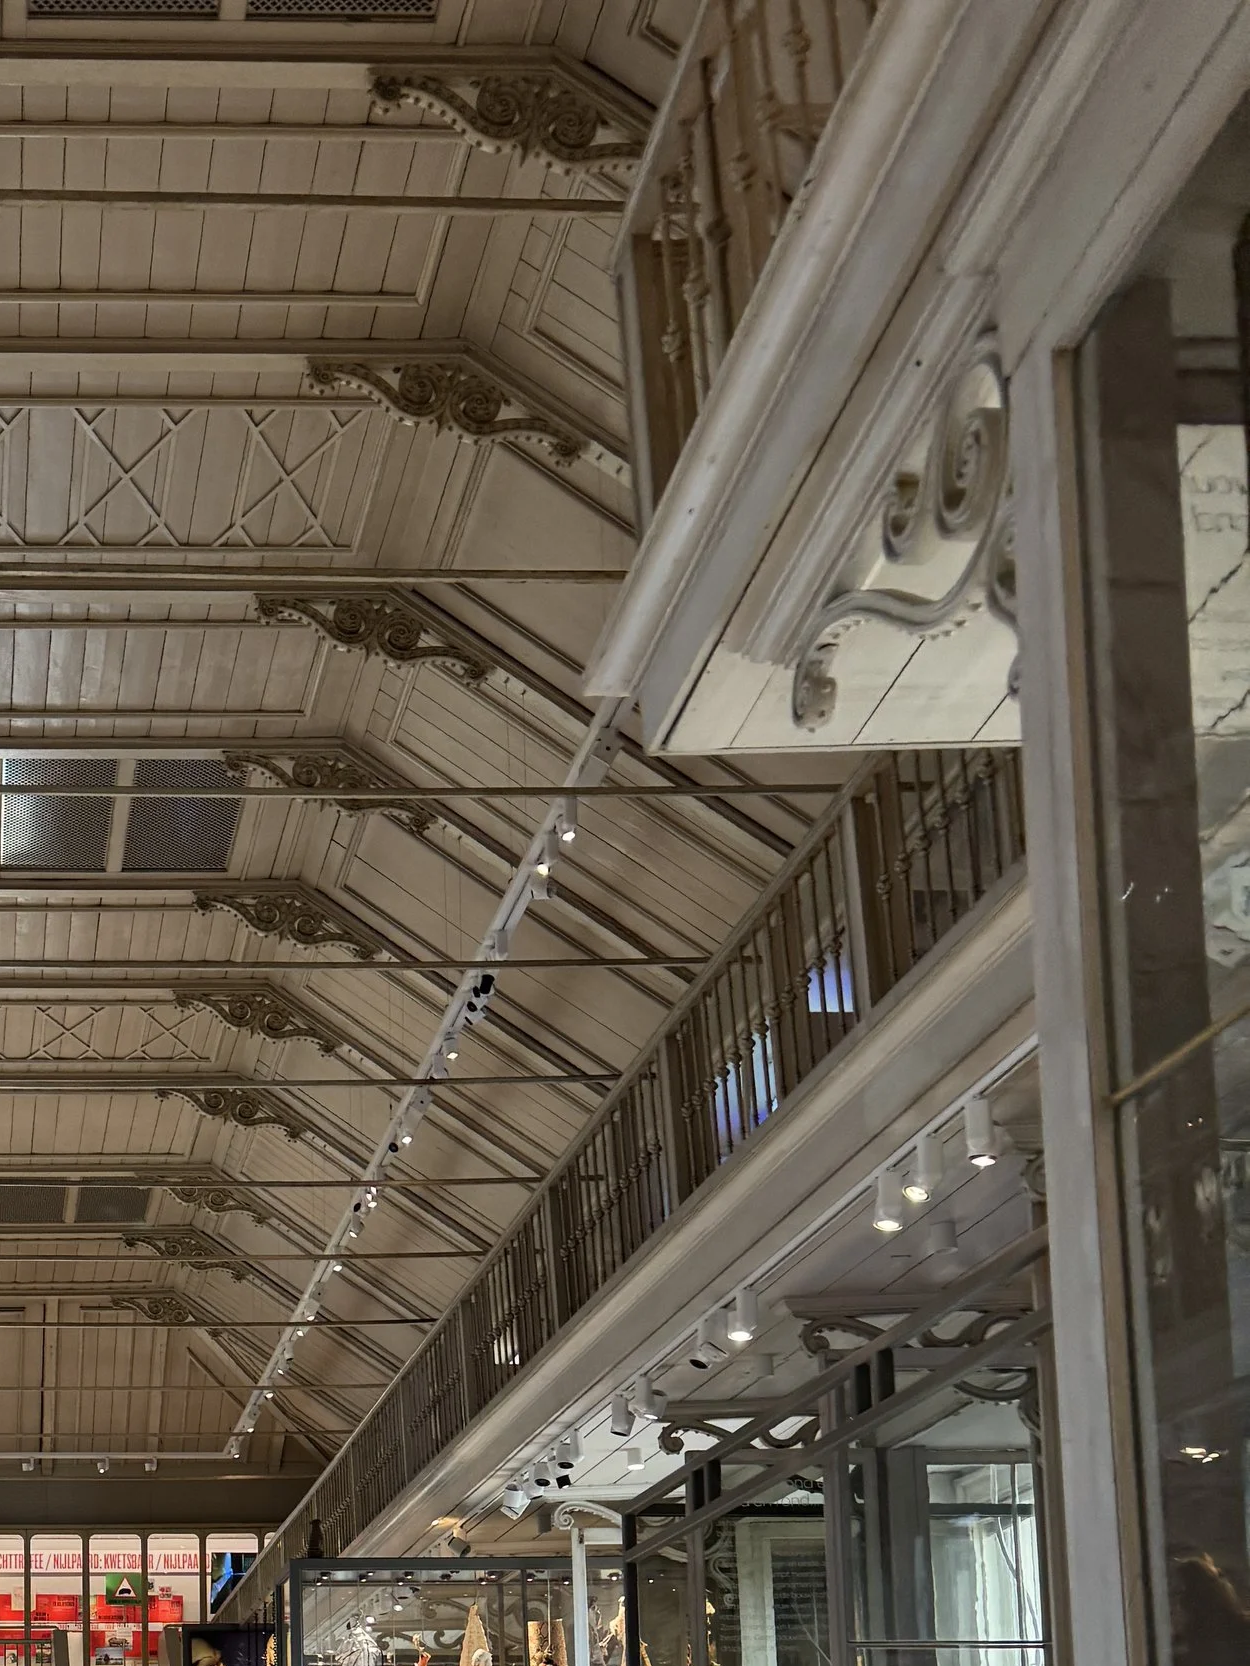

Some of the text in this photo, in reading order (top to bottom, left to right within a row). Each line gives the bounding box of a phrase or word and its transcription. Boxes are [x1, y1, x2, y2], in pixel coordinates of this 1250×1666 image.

[53, 1553, 102, 1569] NIJLPARD:
[104, 1553, 154, 1569] KWETSBAR
[164, 1553, 210, 1569] NIJLPAAD
